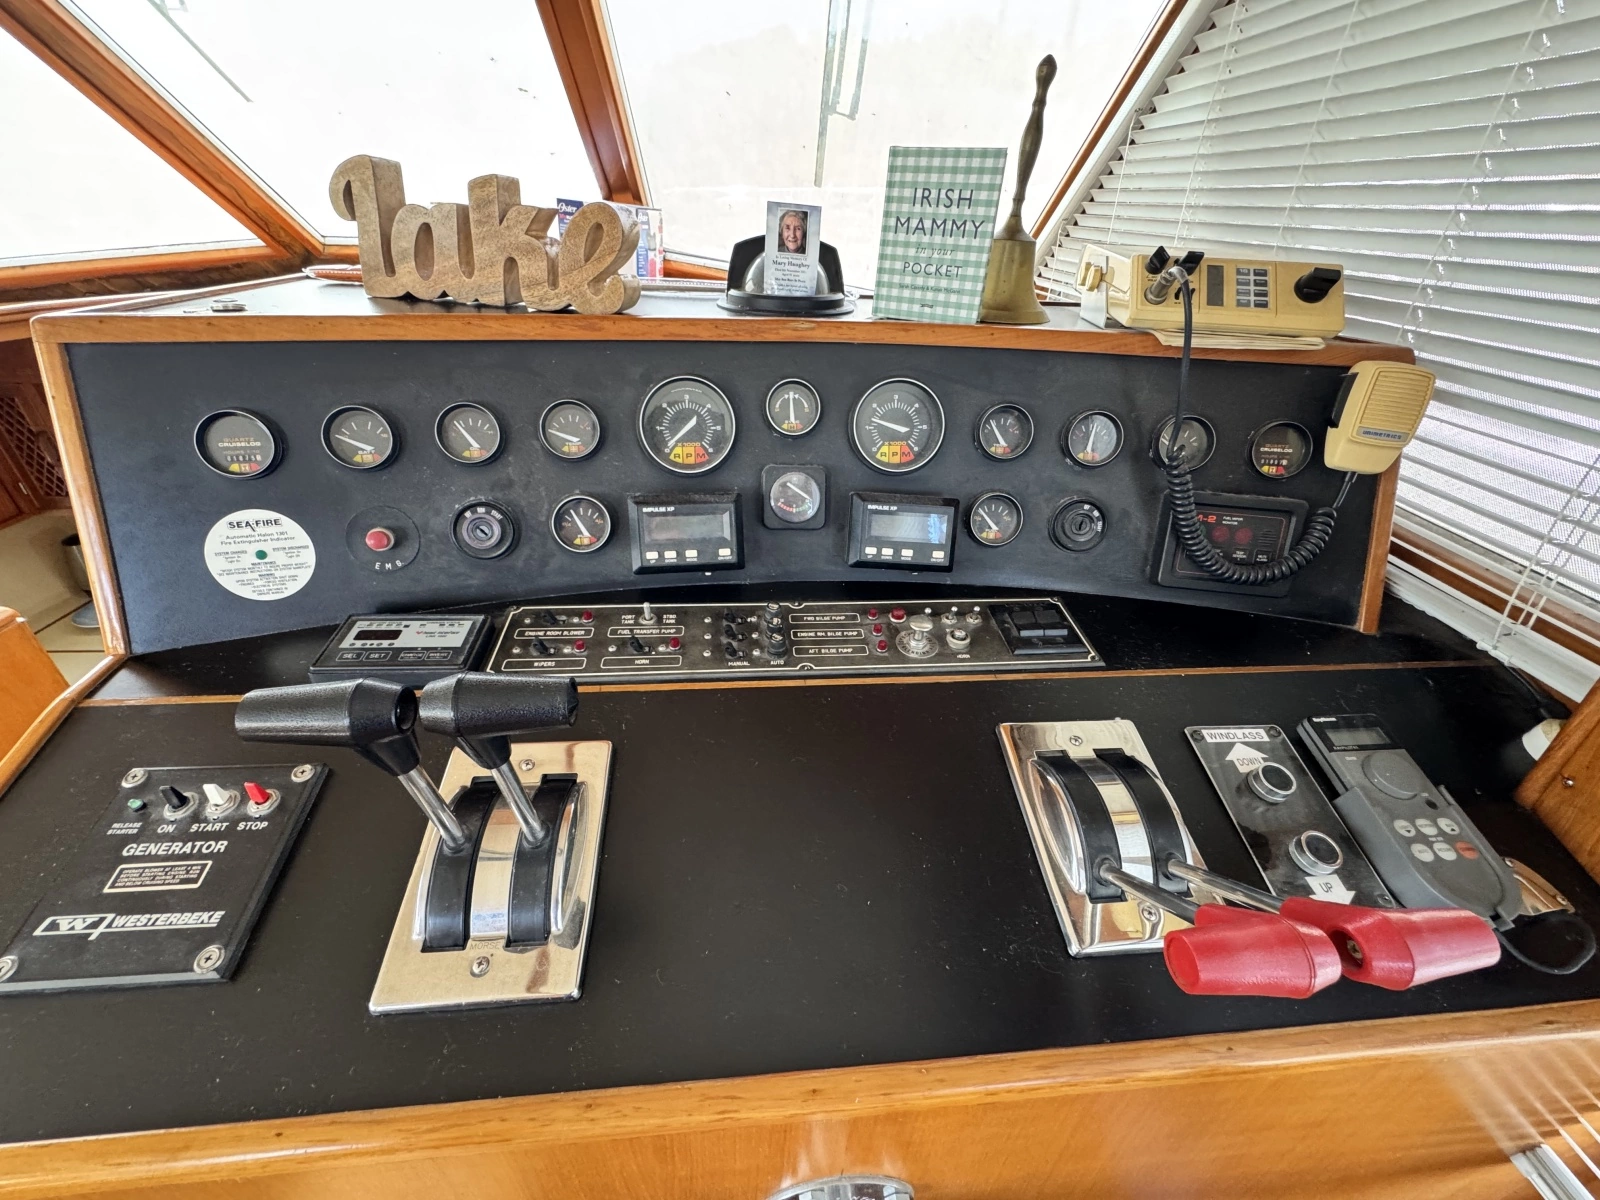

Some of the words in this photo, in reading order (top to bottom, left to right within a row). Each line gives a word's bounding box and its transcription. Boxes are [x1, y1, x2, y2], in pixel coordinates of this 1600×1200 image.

[912, 187, 974, 209] IRISH
[558, 202, 578, 213] Oster
[894, 216, 985, 239] MAMMY
[329, 154, 641, 315] lake
[916, 244, 926, 254] in
[928, 248, 955, 258] your
[903, 262, 962, 278] POCKET
[1206, 732, 1264, 740] WINDLASS
[1237, 757, 1262, 766] DOWN
[156, 824, 177, 833] ON
[188, 822, 229, 832] START
[237, 821, 268, 831] STOP
[121, 840, 228, 856] GENERATOR
[1319, 882, 1332, 893] UP
[55, 918, 100, 931] W
[112, 911, 226, 928] WESTERBEKE
[470, 942, 501, 950] MORSE
